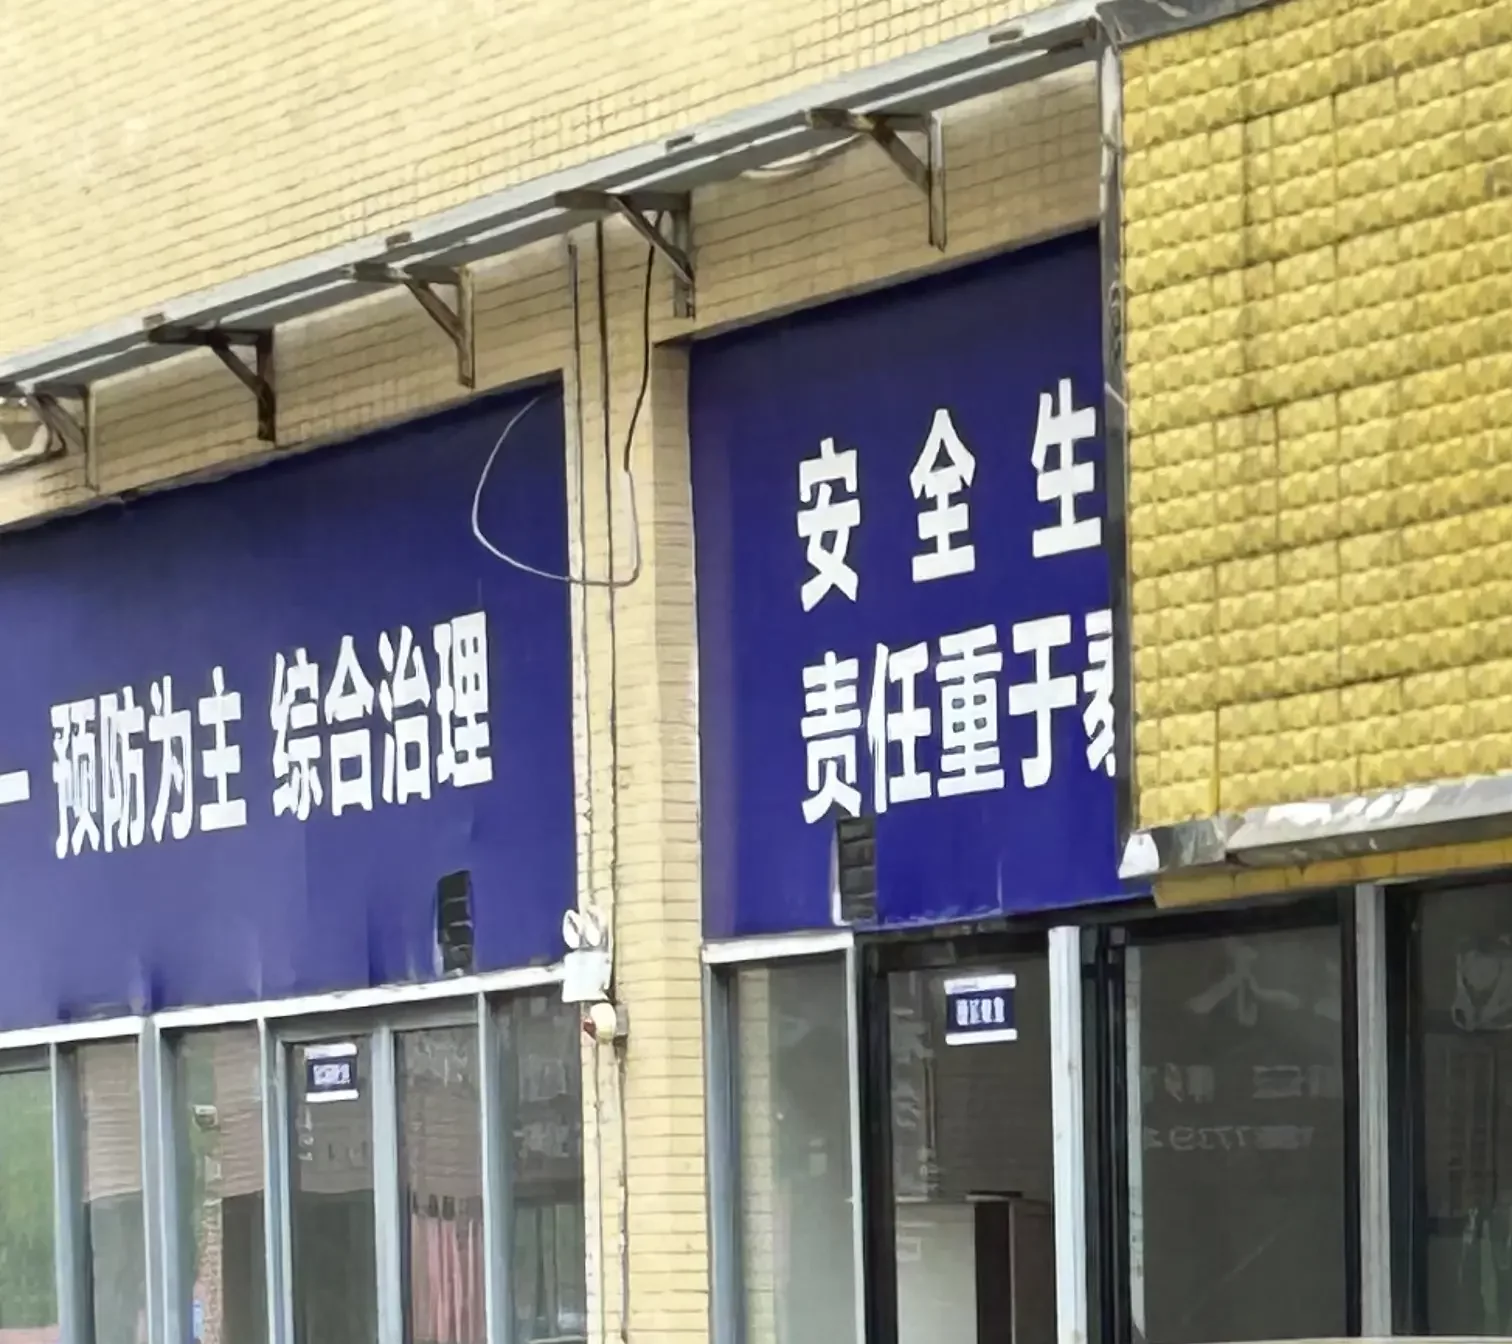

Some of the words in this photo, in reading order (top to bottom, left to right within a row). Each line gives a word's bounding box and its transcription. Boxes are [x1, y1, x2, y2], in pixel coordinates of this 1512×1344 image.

[796, 377, 1102, 613] 安全生
[50, 665, 248, 860] 预防为主
[270, 610, 493, 821] 综合治理
